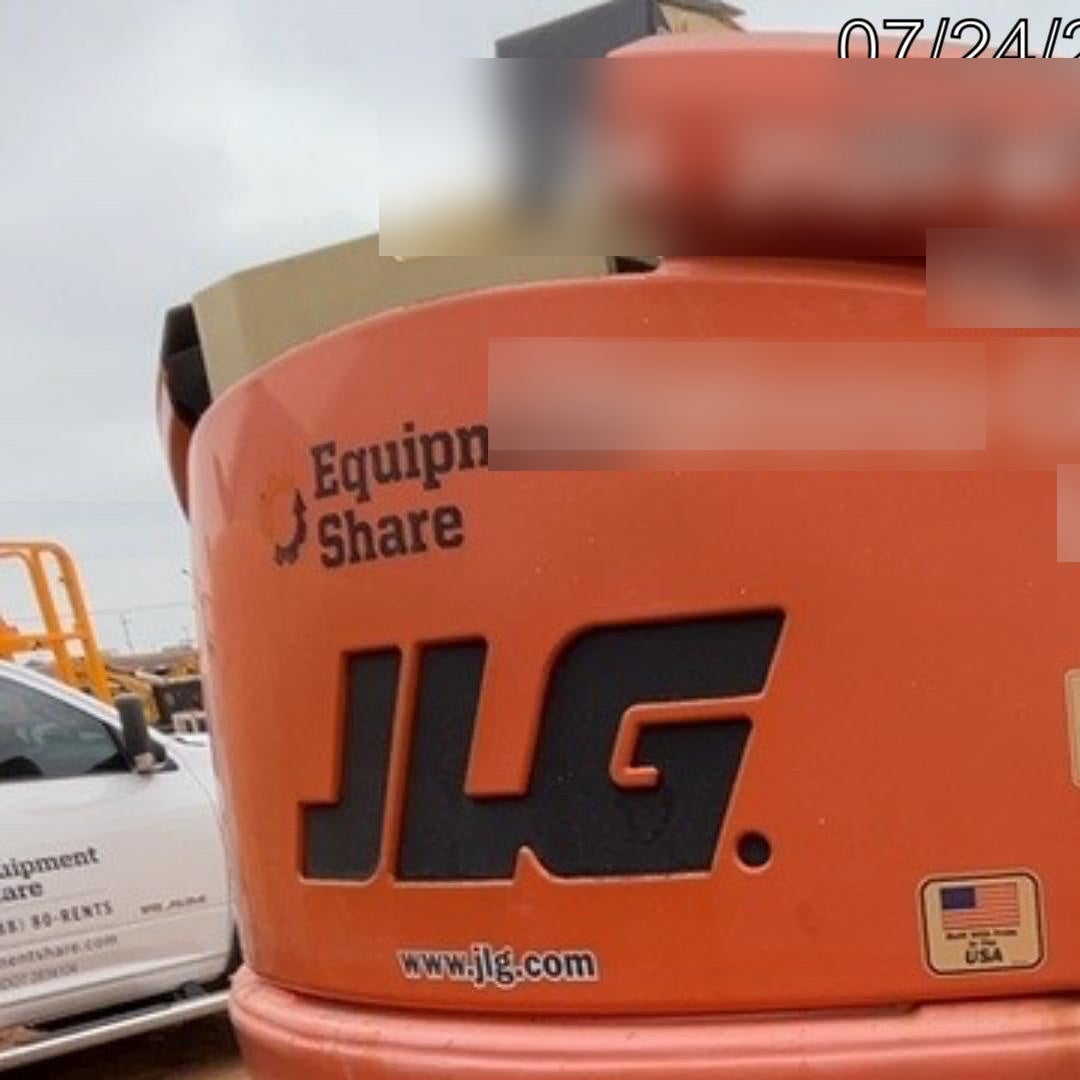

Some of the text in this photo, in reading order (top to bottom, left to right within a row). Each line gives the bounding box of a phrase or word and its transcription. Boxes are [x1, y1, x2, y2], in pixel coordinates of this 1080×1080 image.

[317, 503, 464, 569] Share
[0, 881, 43, 902] are
[31, 899, 114, 930] 80-RENTS
[401, 945, 596, 985] www.jlg.com
[965, 946, 1003, 965] USA
